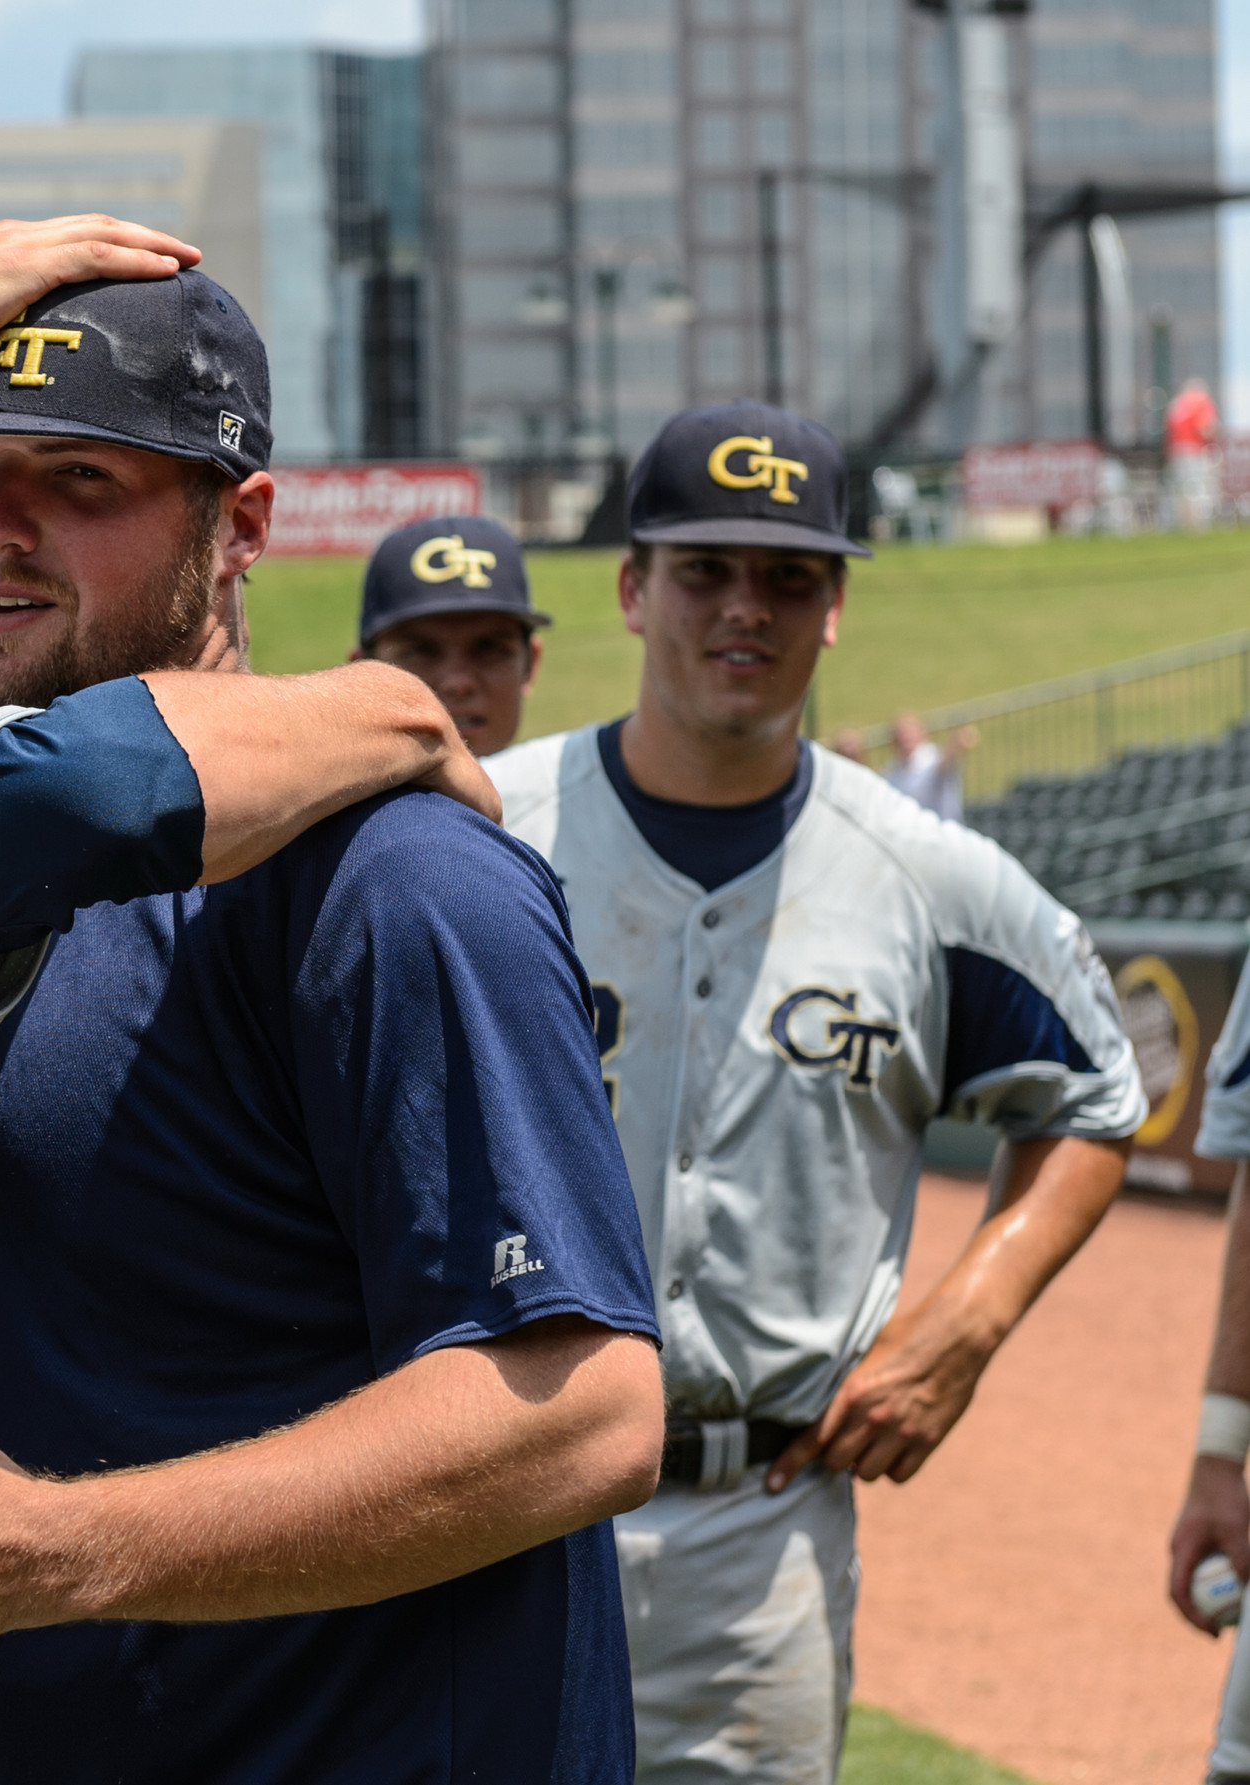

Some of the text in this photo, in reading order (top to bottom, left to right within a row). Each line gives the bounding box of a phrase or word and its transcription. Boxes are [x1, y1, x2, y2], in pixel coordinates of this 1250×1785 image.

[707, 435, 809, 504] GT
[410, 534, 497, 589] GT
[770, 982, 900, 1091] GT
